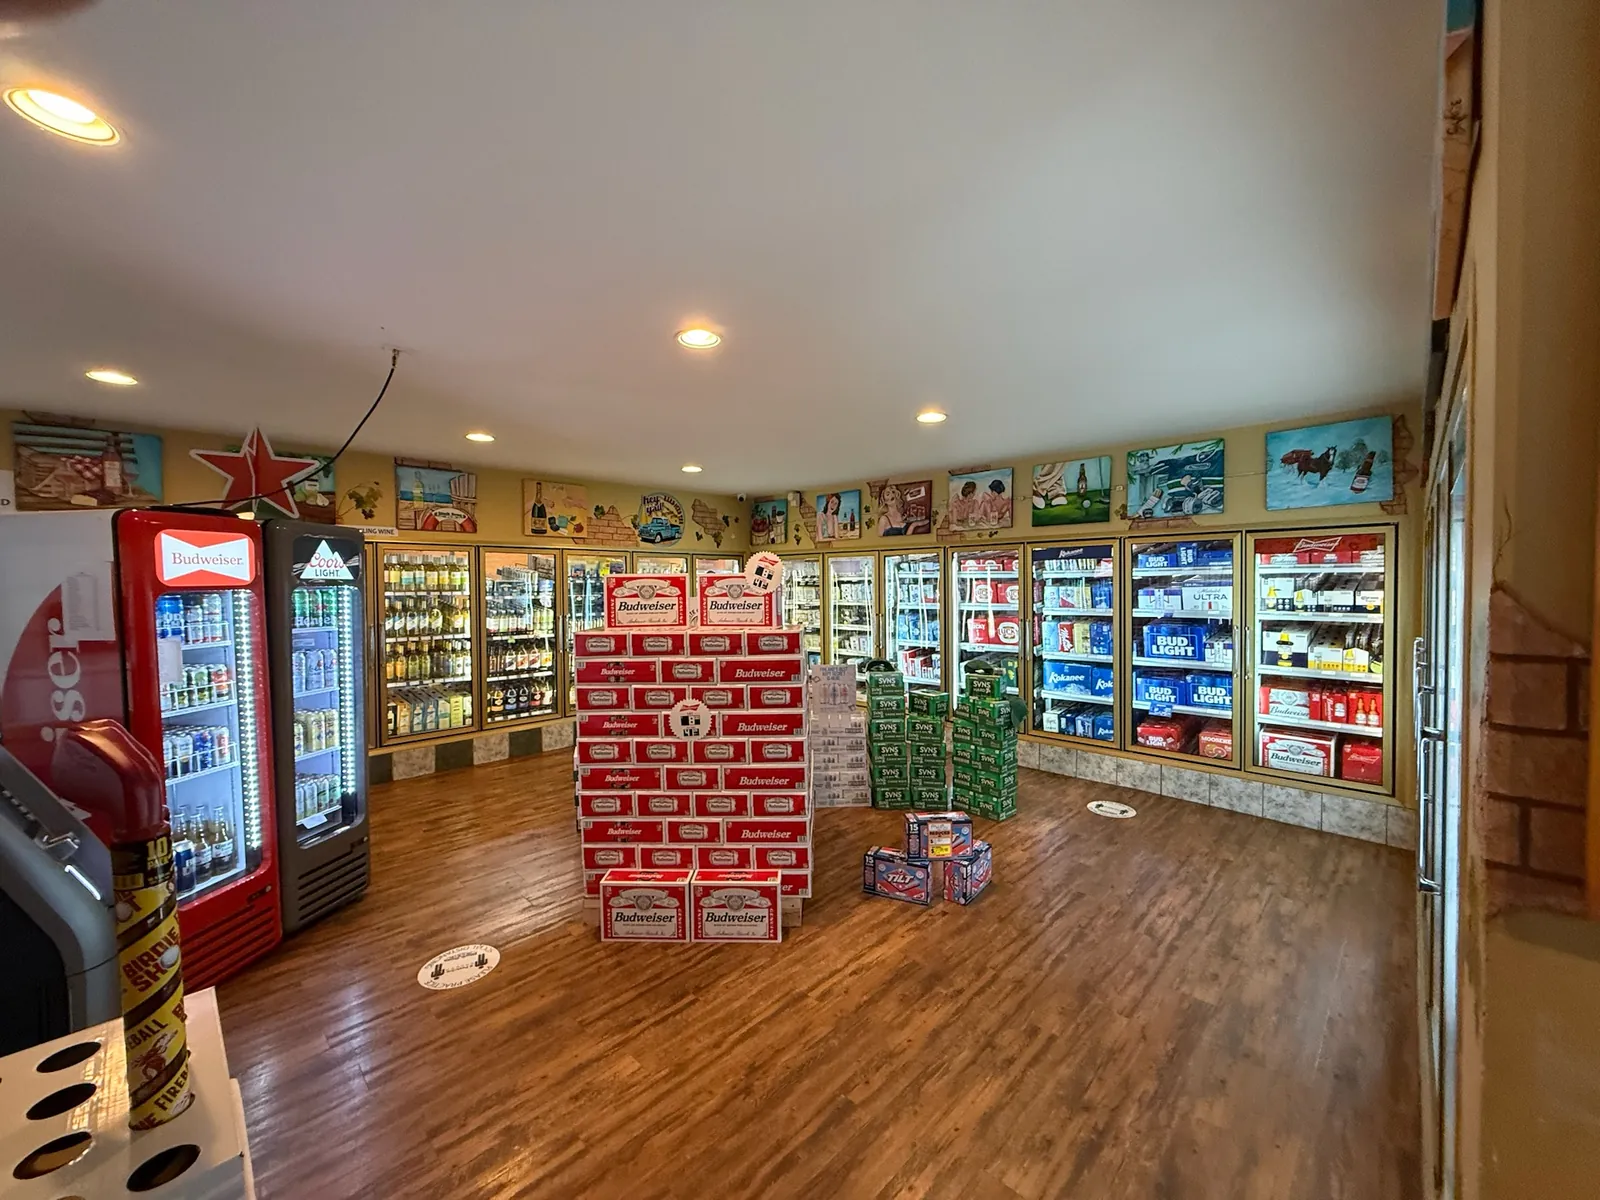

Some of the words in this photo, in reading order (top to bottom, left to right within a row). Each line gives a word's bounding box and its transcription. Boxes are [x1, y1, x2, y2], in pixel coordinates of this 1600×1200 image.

[172, 552, 243, 565] Budweiser
[309, 552, 345, 568] Coors
[315, 569, 340, 577] LIGHT
[1194, 593, 1228, 601] ULTRA
[618, 601, 676, 611] Budweiser
[710, 600, 763, 610] Budweiser
[1157, 636, 1188, 646] BUD
[1152, 645, 1195, 656] LIGHT
[735, 669, 786, 678] Budweiser
[1049, 672, 1086, 683] Kokanee
[1095, 679, 1113, 690] Kok
[1149, 686, 1172, 695] BUD
[1198, 686, 1226, 696] BUD
[1145, 693, 1176, 702] LIGHT
[1193, 694, 1232, 704] LIGHT
[880, 700, 897, 708] SVNS
[1271, 705, 1309, 717] Budweiser
[737, 723, 788, 731] Budweiser
[1271, 753, 1322, 767] Budweiser
[739, 777, 790, 785] Budweiser
[741, 830, 792, 839] Budweiser
[147, 836, 168, 859] 10
[865, 856, 874, 864] 15
[887, 874, 915, 884] TILT
[614, 912, 675, 923] Budweiser
[705, 912, 766, 923] Budweiser
[122, 927, 180, 978] BIRDIE
[127, 1018, 169, 1051] EBALL
[153, 1066, 189, 1112] FIREB
